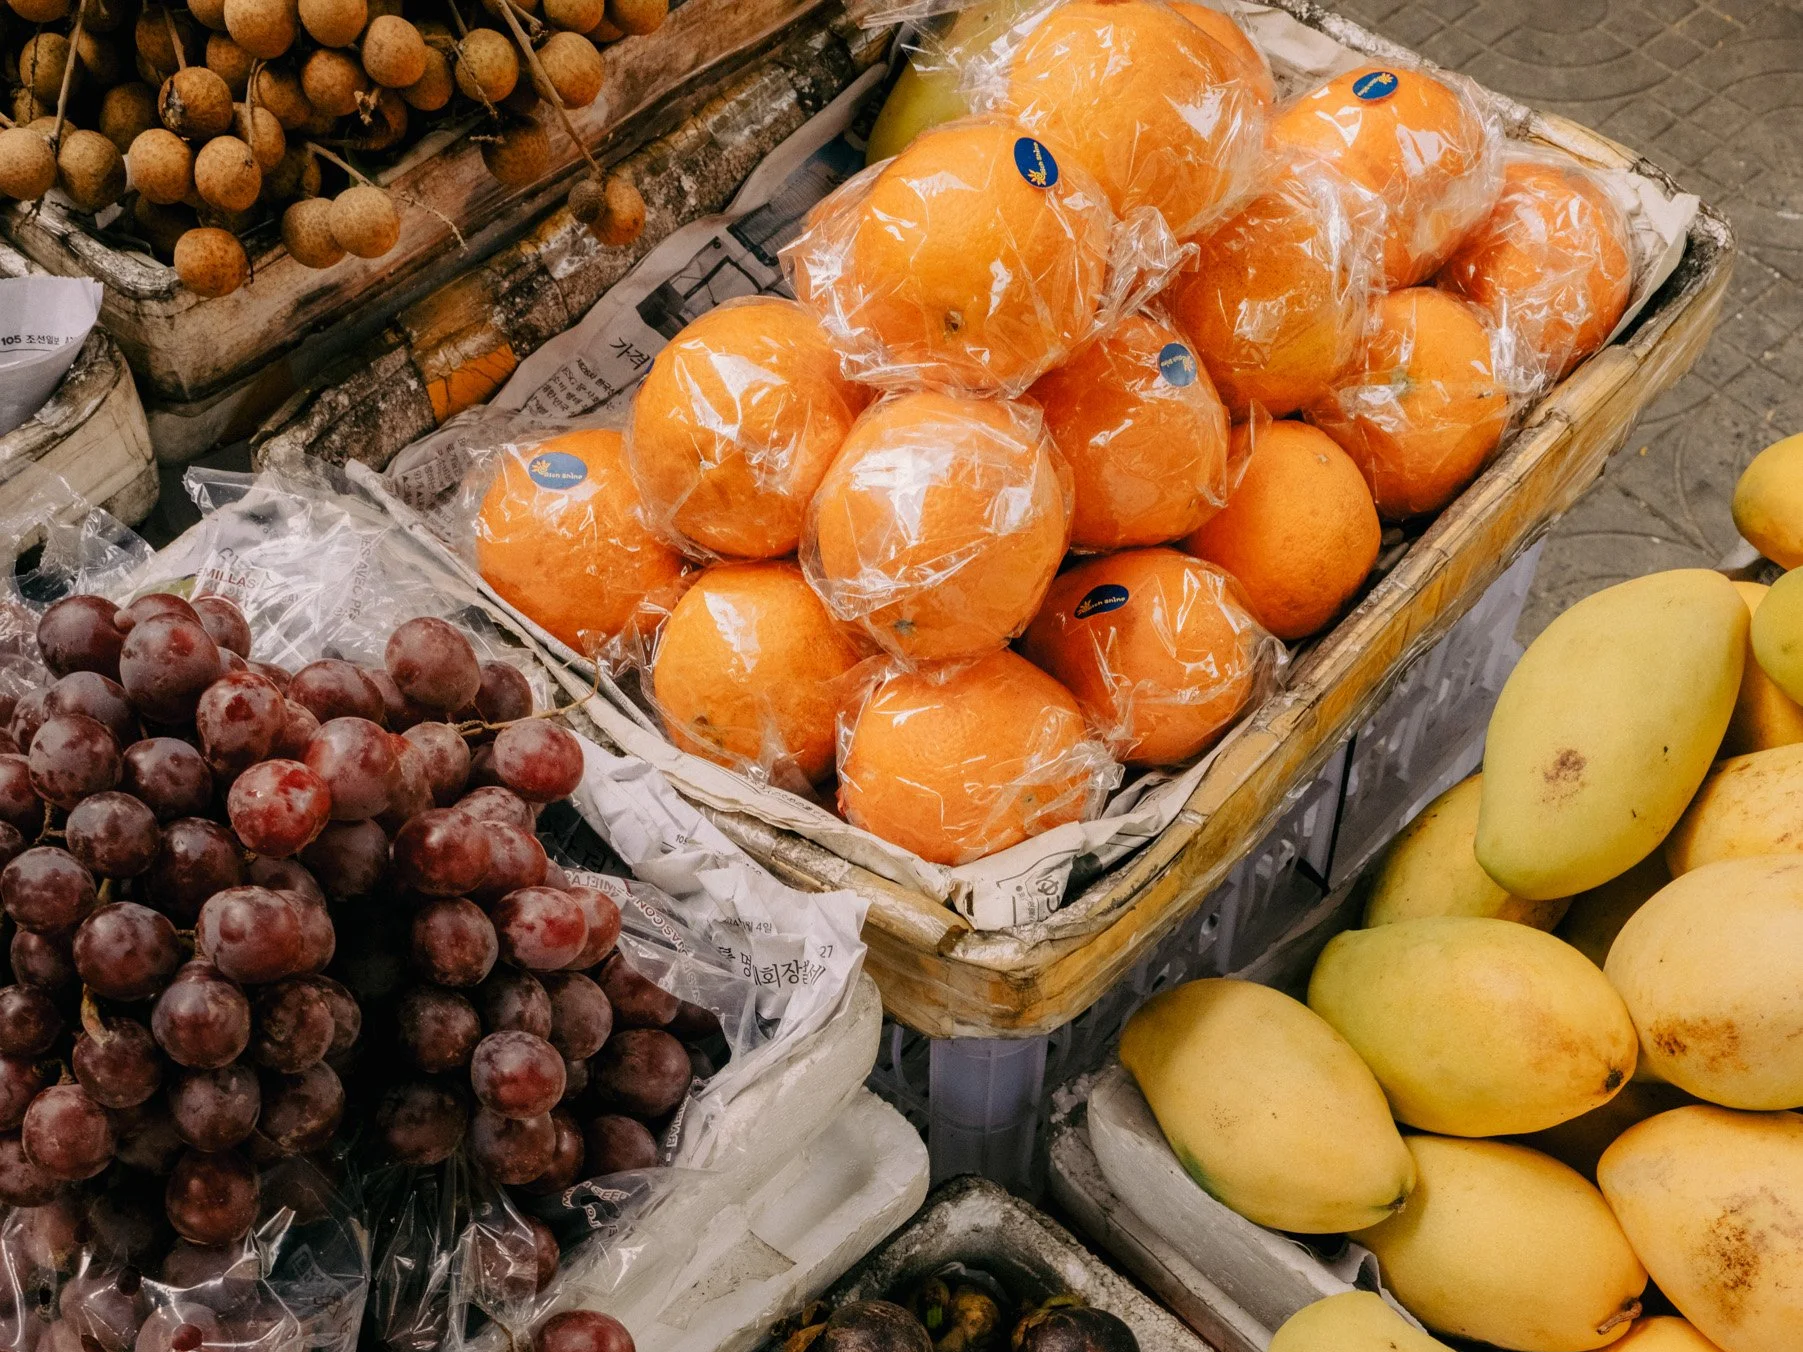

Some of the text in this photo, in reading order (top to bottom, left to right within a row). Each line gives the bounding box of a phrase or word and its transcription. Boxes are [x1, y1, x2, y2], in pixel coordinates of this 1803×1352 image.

[609, 337, 650, 371] 가격
[196, 566, 258, 590] EMILLAS
[819, 945, 833, 959] 27
